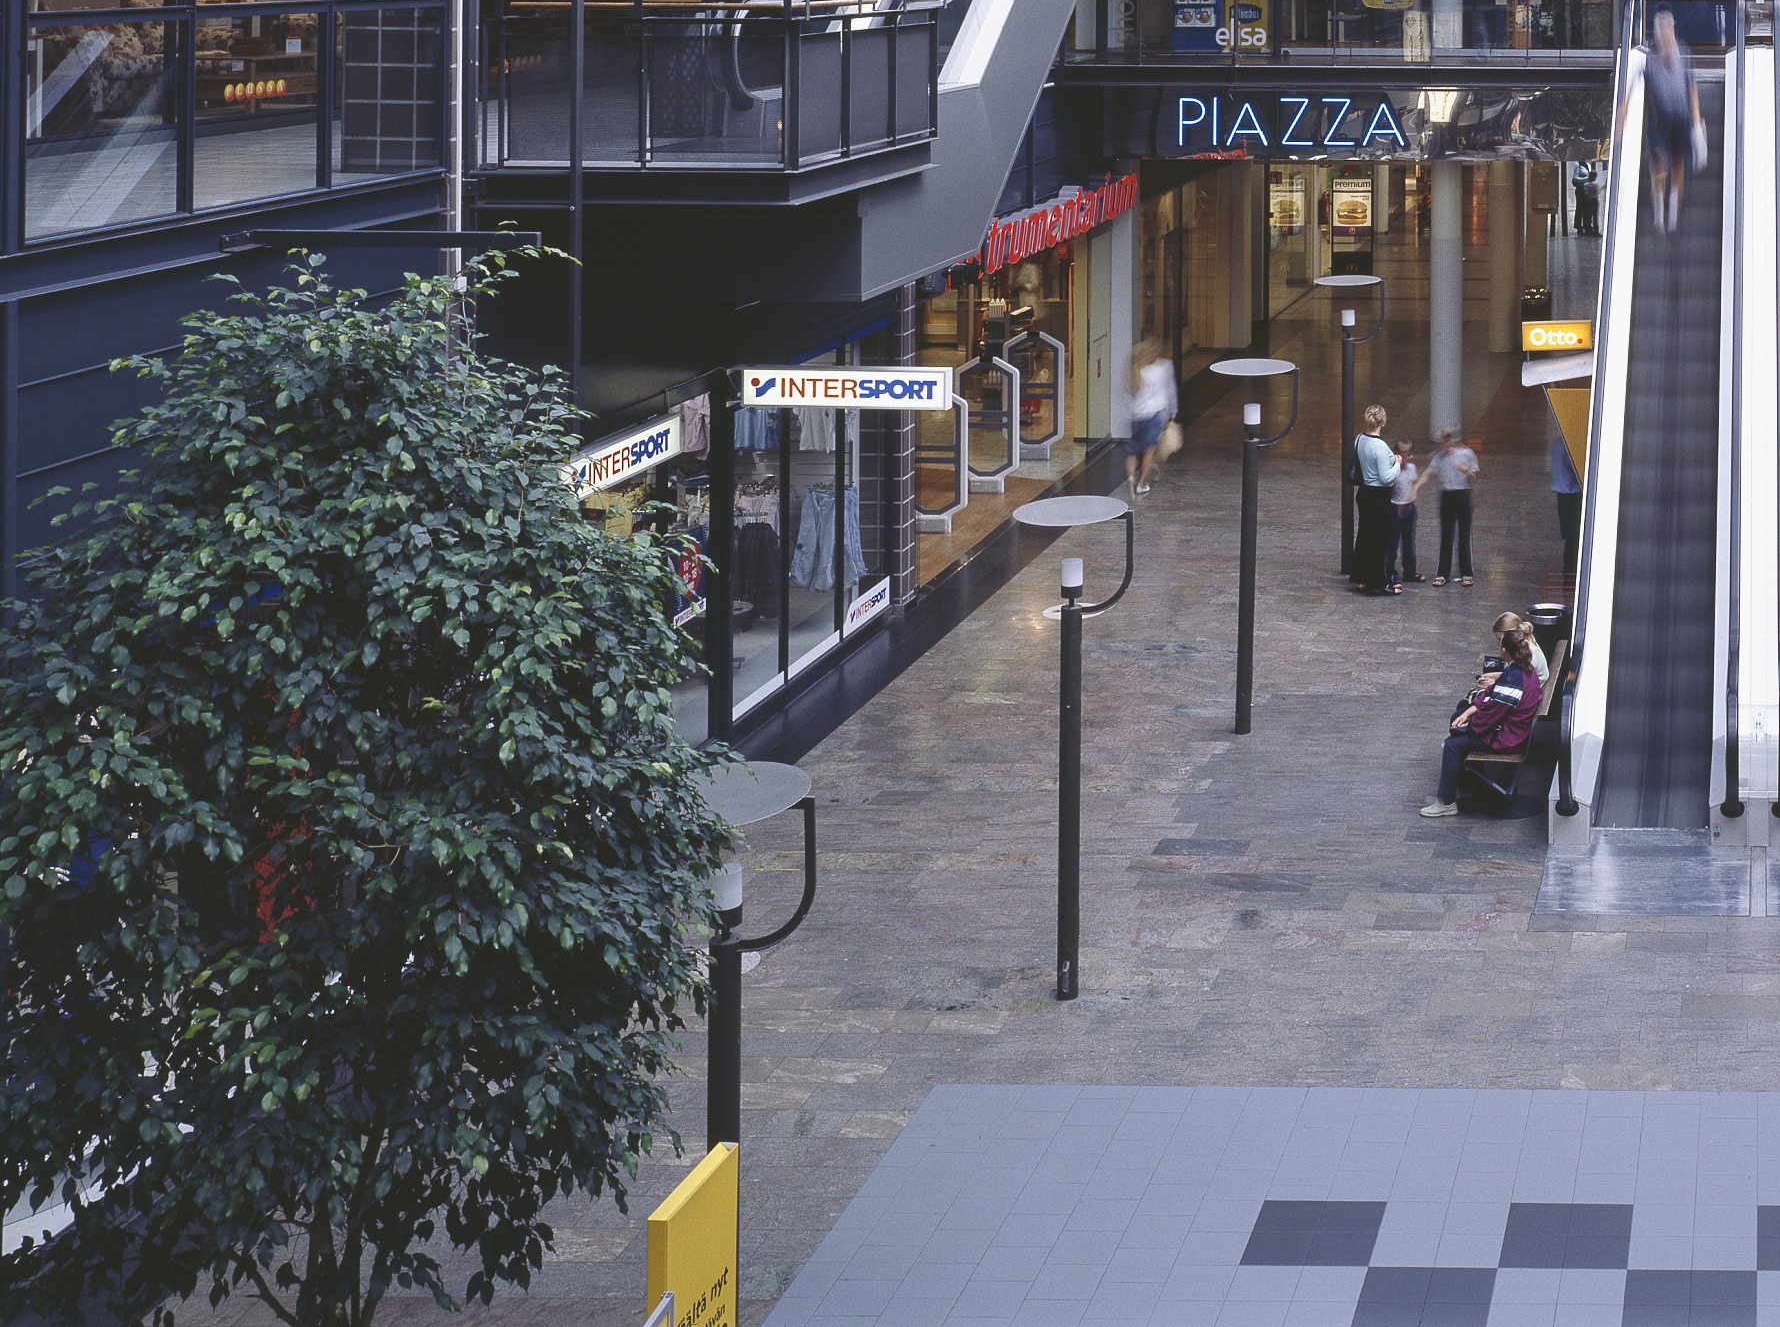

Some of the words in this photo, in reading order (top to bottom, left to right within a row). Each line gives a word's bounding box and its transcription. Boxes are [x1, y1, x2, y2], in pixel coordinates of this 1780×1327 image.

[1215, 18, 1266, 46] elisa
[225, 81, 284, 97] PLUSSA
[1177, 96, 1406, 147] PIAZZA
[968, 171, 1138, 280] trumentarium
[780, 377, 938, 400] INTERSPORT
[588, 427, 671, 485] INTERSPORT
[710, 1266, 729, 1302] nyt
